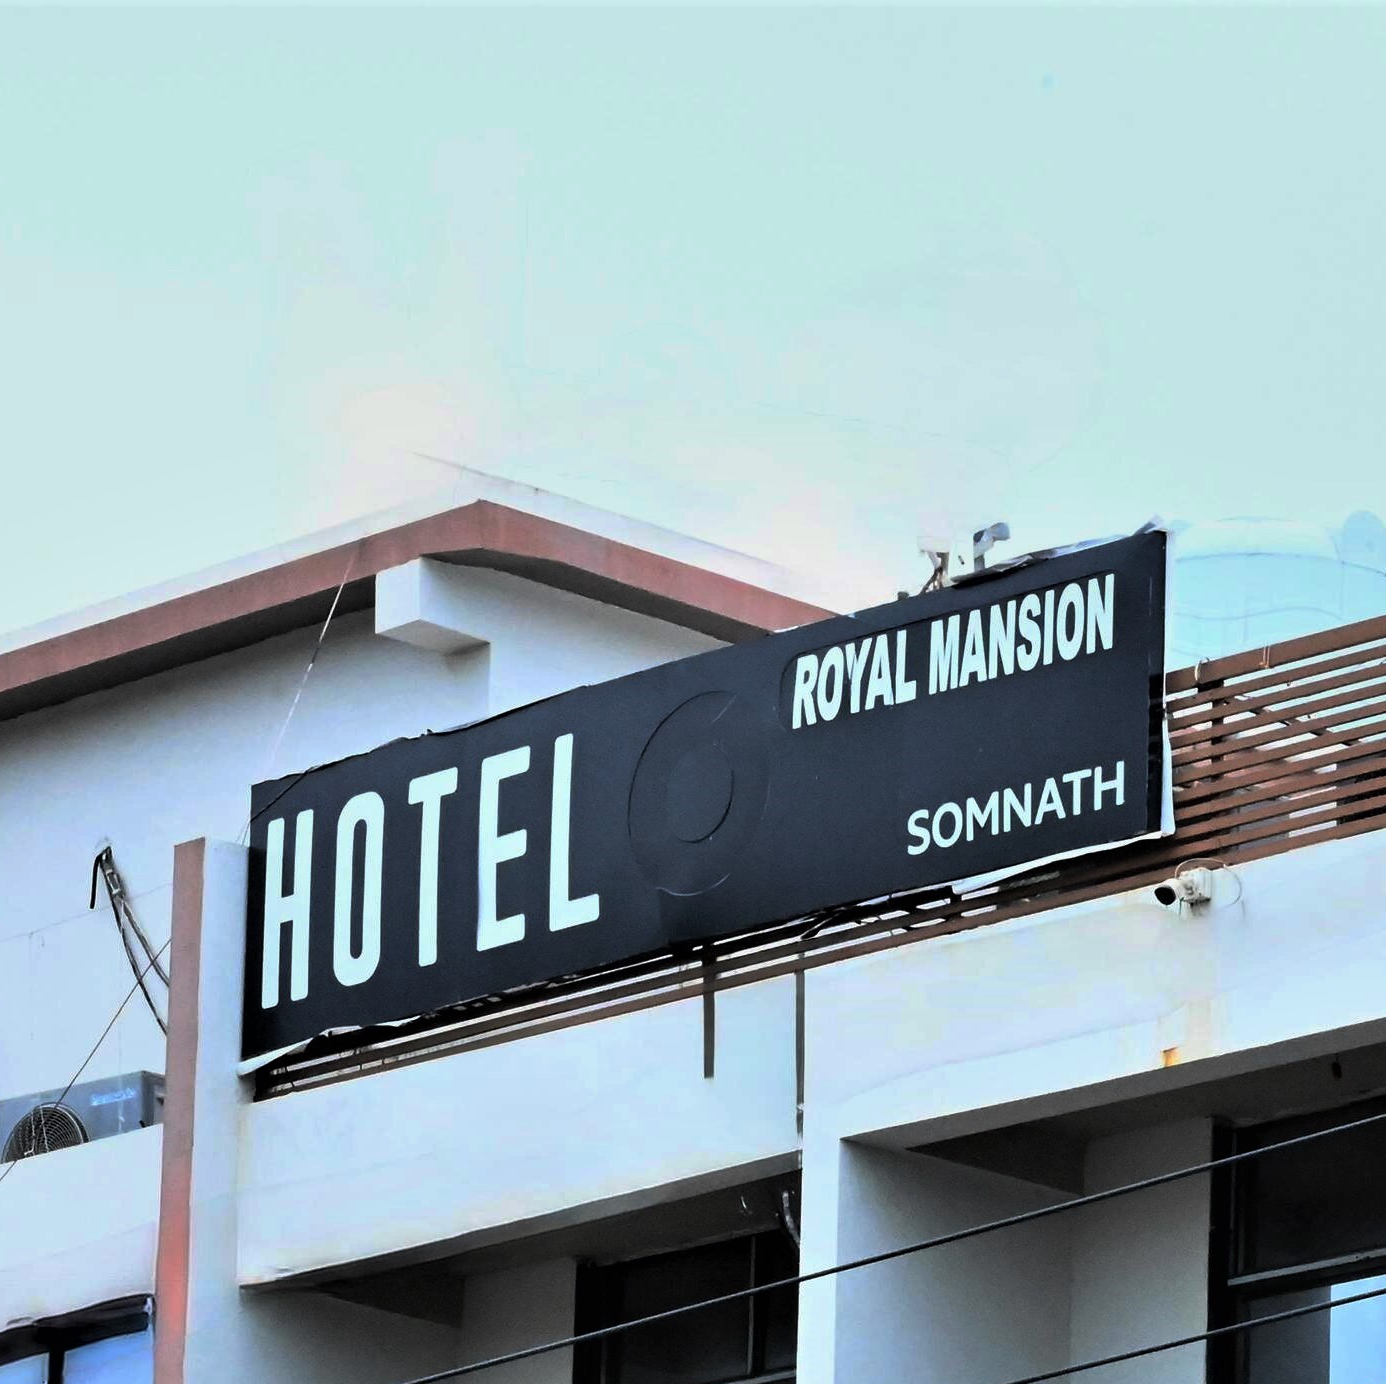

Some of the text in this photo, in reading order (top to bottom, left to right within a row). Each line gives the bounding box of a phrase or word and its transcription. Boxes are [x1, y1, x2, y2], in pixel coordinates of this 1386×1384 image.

[793, 574, 1114, 729] ROYAL MANSION
[262, 734, 599, 1009] HOTEL
[908, 761, 1124, 855] SOMNATH
